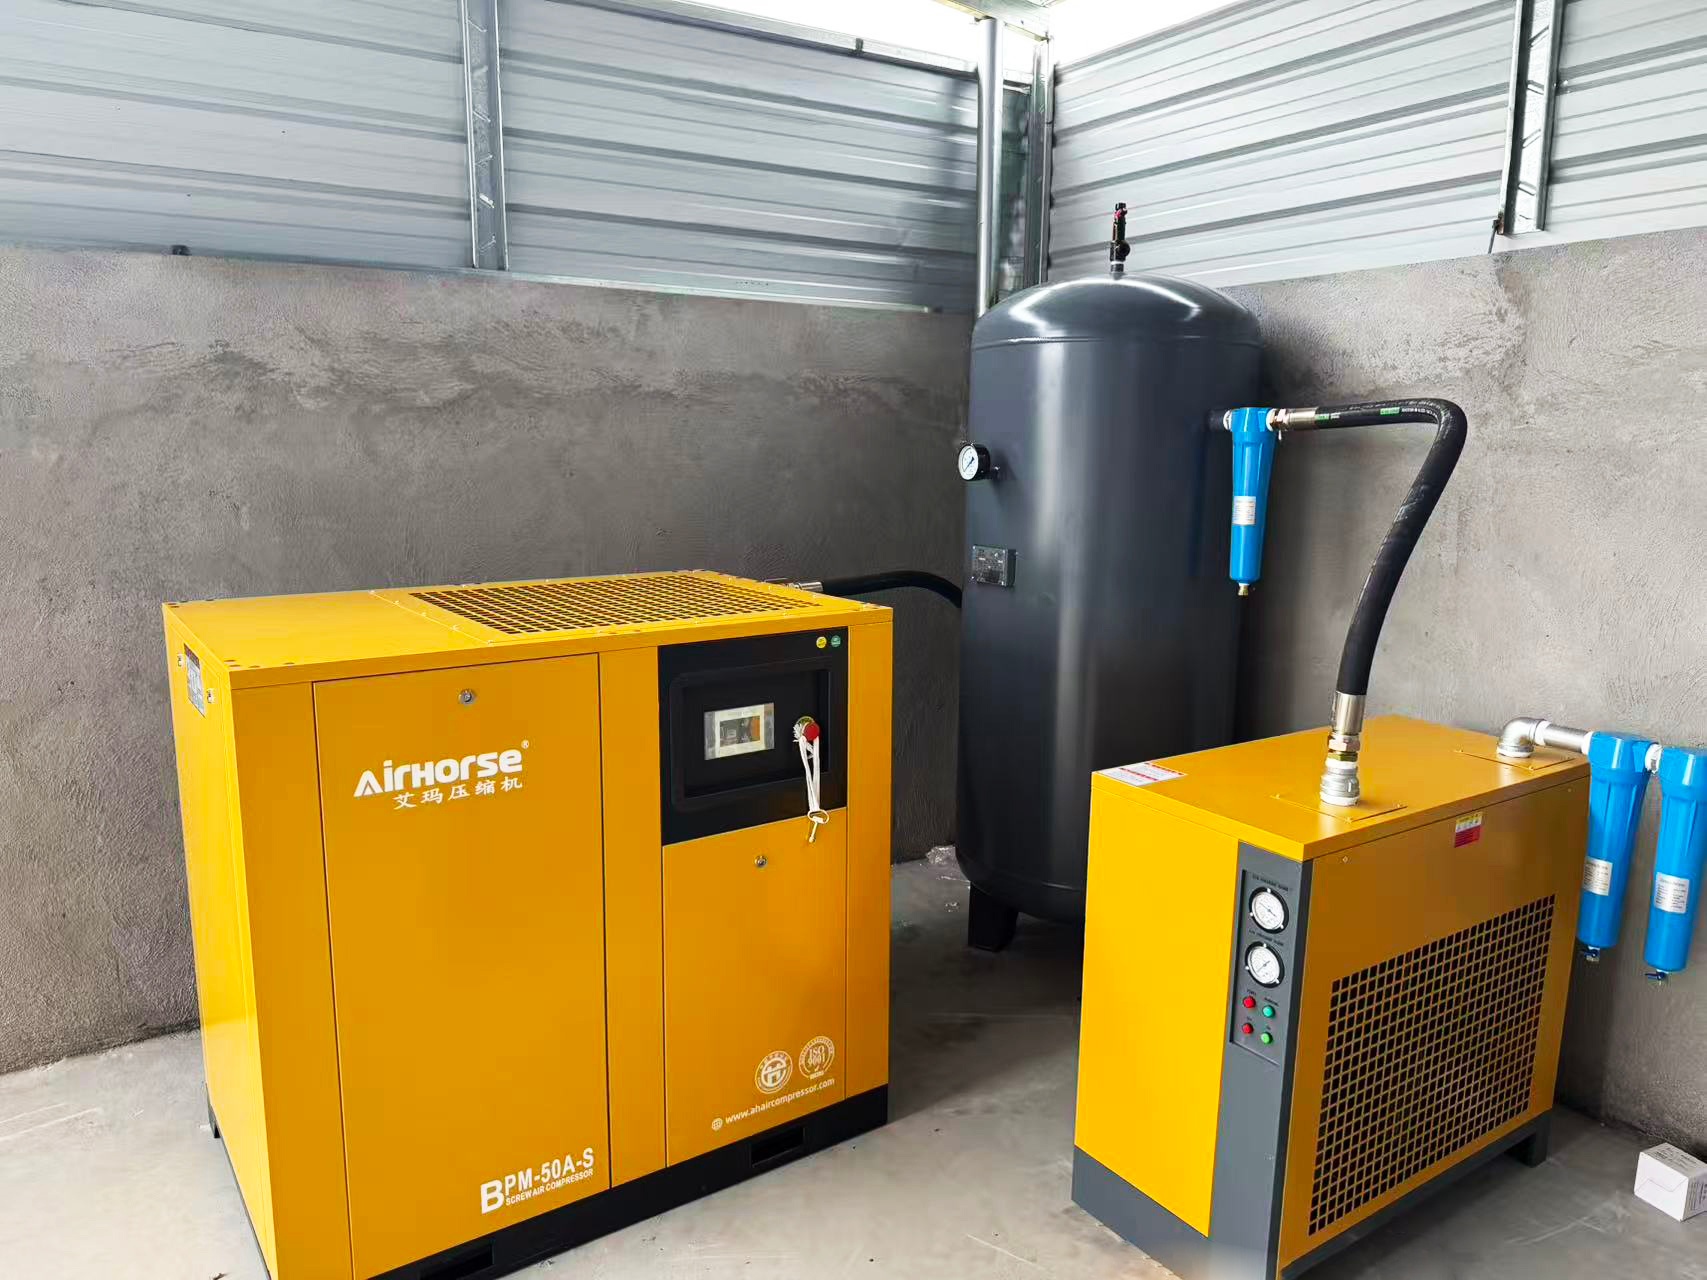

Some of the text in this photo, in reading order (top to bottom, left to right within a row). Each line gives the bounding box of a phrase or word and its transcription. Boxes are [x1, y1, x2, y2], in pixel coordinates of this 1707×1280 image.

[393, 776, 523, 810] 艾玛压缩机
[808, 1045, 825, 1058] ISO
[725, 1078, 835, 1124] www.ahaircompressor.com
[480, 1147, 595, 1215] BPM-50A-S
[505, 1168, 594, 1206] SCREW AIR COMPRESSOR
